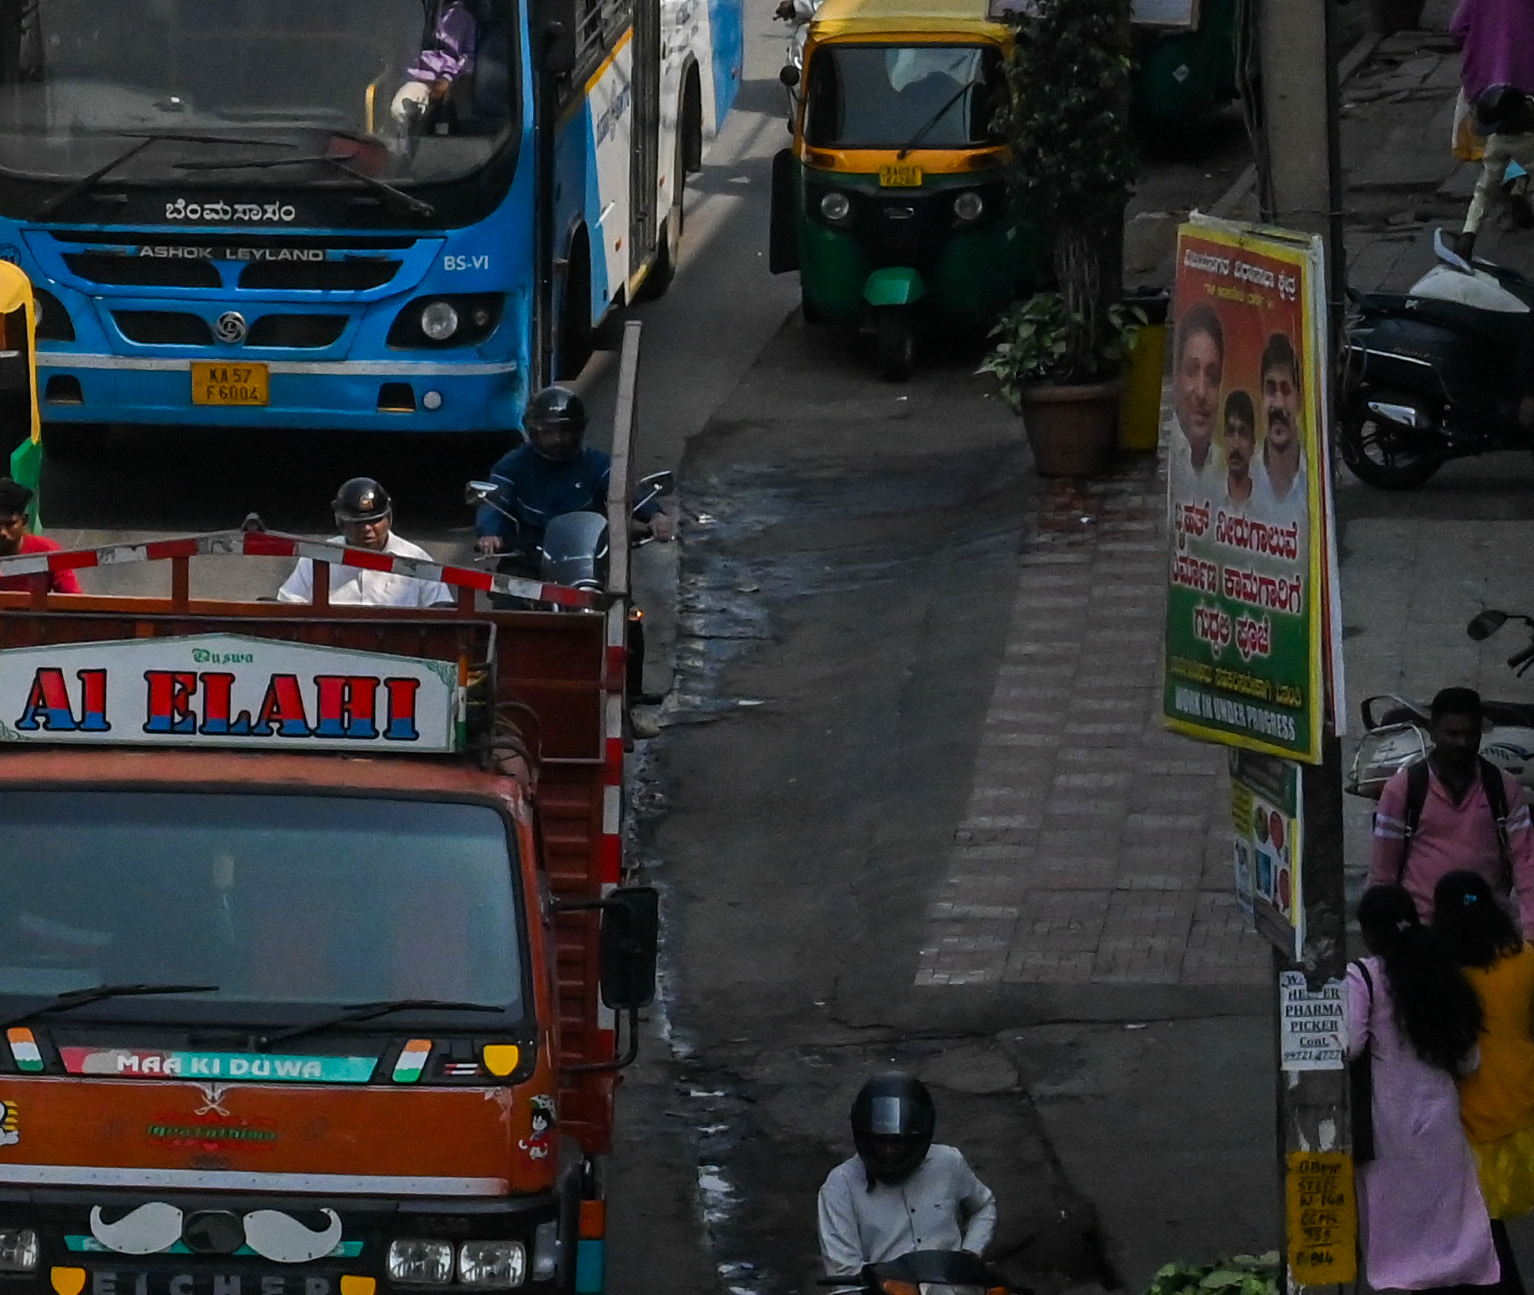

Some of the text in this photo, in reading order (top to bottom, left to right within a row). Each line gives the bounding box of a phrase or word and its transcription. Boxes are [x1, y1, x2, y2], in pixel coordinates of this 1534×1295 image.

[140, 244, 324, 262] ASHOK LEYLAND
[444, 255, 490, 271] BS-VI
[142, 668, 421, 741] ELAHI
[1285, 1003, 1344, 1017] PHARMA
[1290, 1019, 1339, 1033] PICKER
[116, 1054, 323, 1078] MAA KI DUWA
